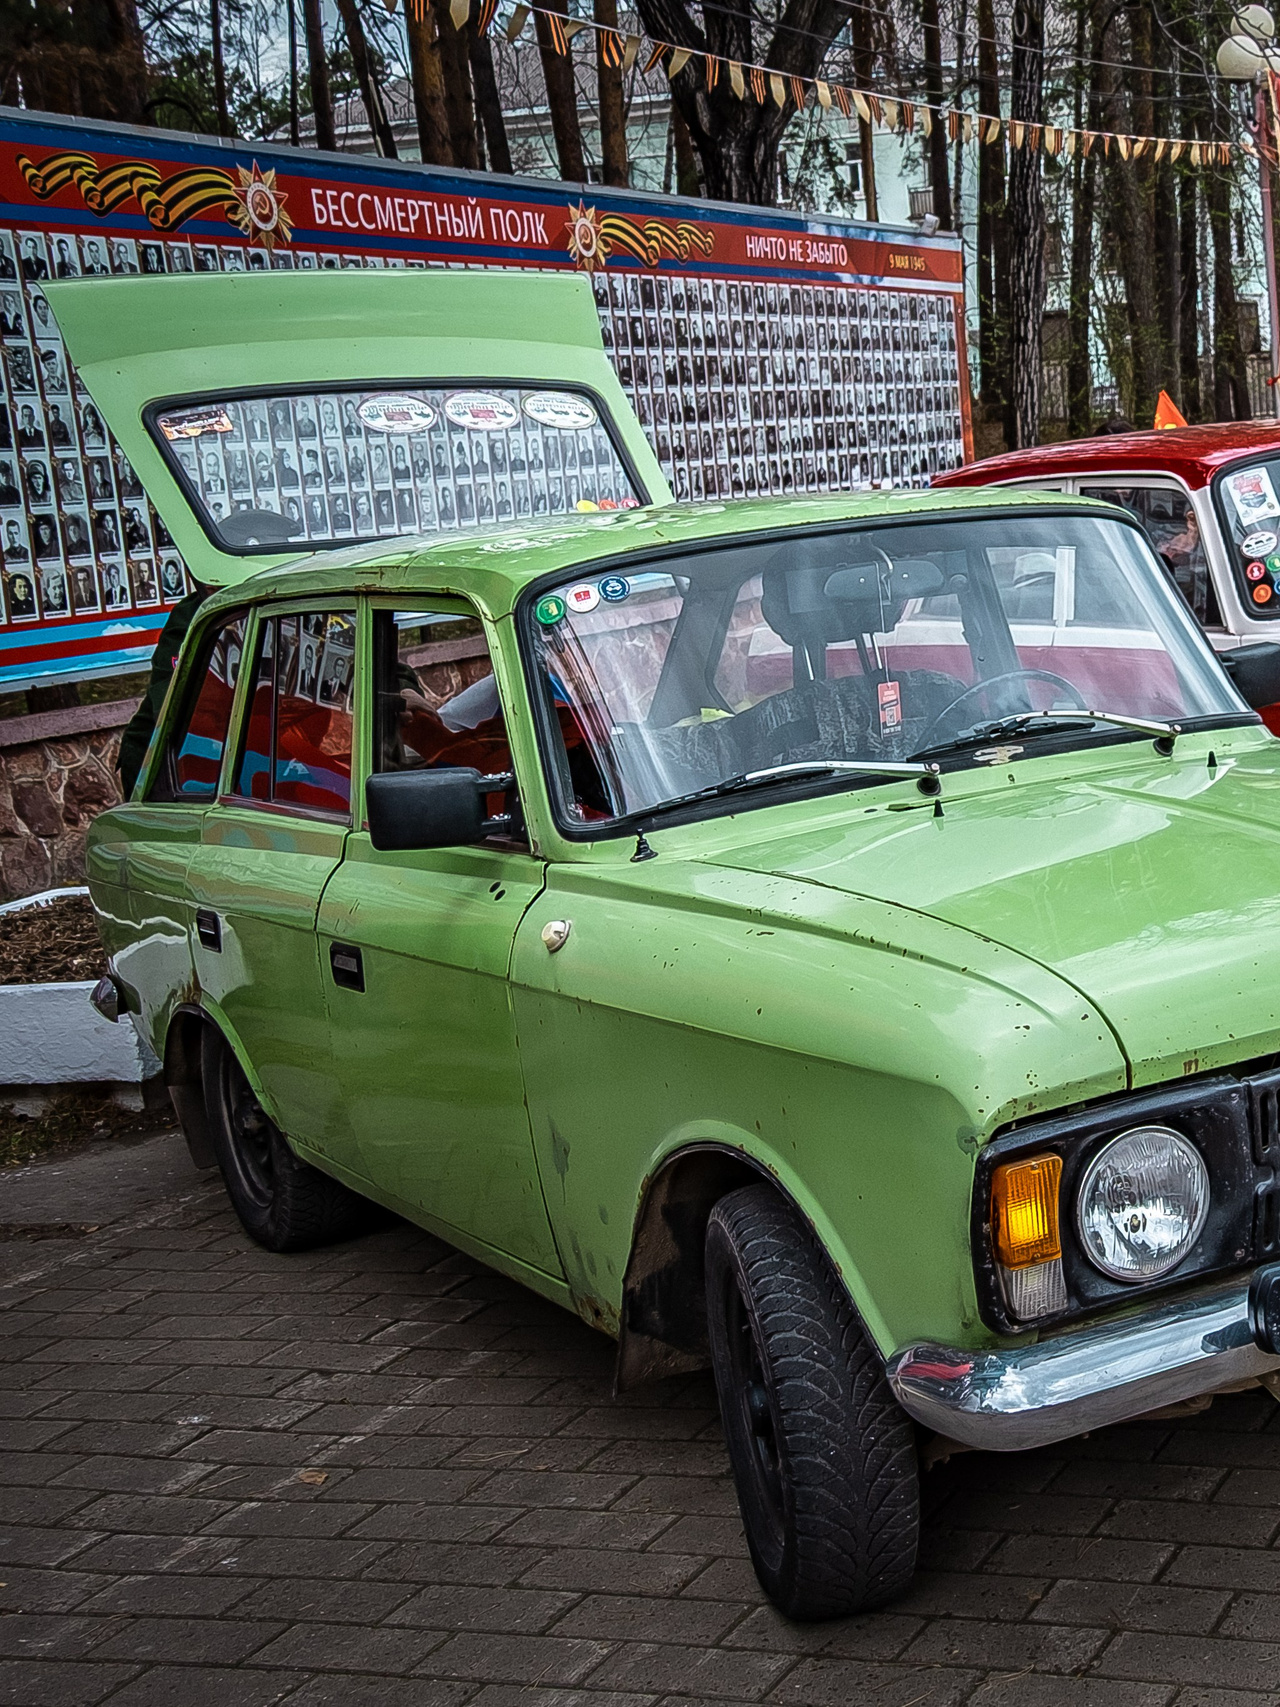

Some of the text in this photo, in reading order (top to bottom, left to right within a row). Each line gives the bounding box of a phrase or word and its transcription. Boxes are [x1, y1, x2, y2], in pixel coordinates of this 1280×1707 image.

[311, 188, 485, 239] БЕССМЕРТНЫЙ
[490, 207, 549, 245] ПОЛК
[745, 234, 848, 266] НИЧТО НЕ ЗАБЫТО
[889, 253, 895, 268] 9
[909, 256, 926, 271] 1945
